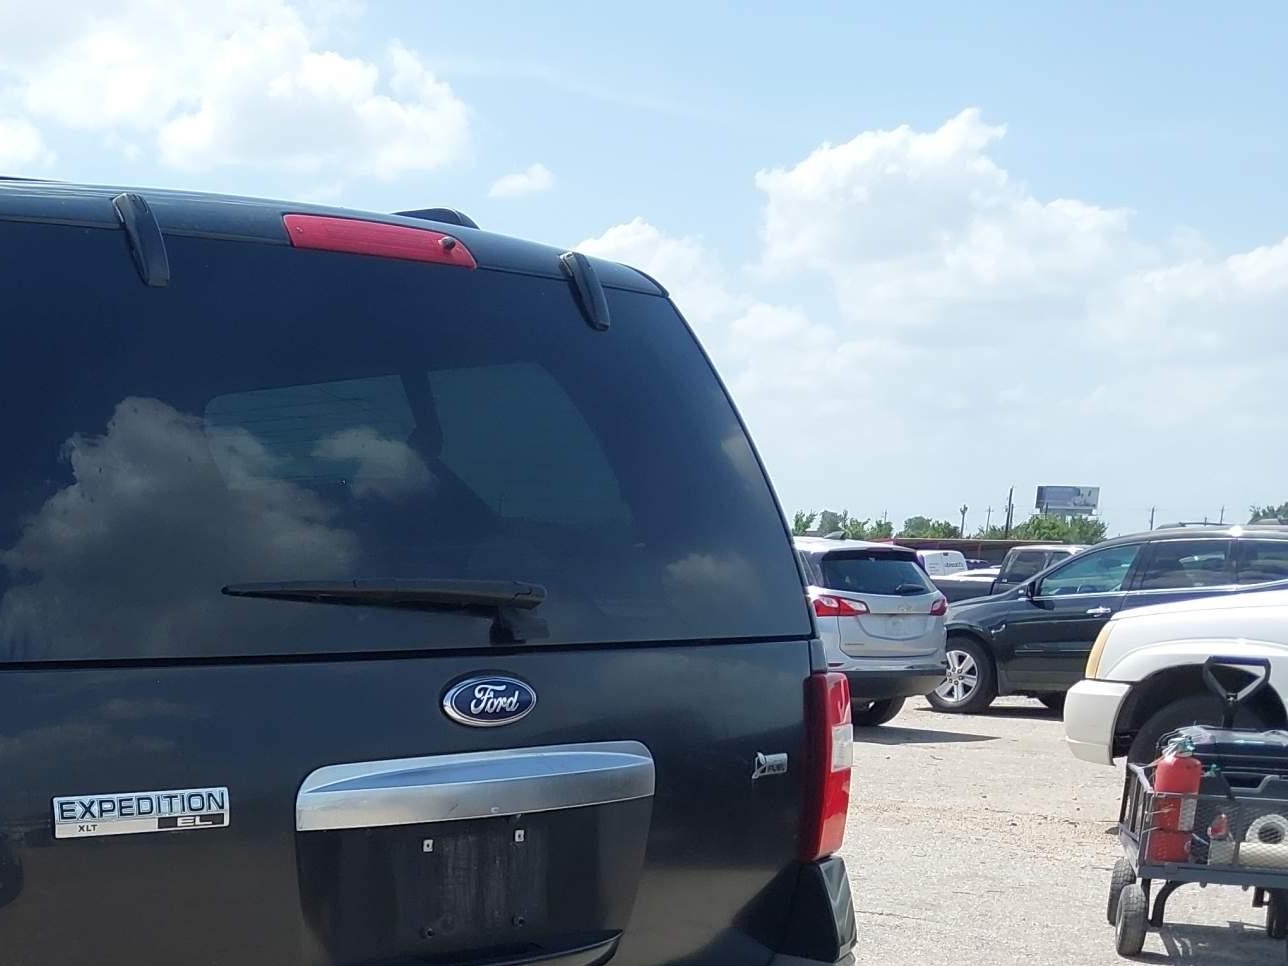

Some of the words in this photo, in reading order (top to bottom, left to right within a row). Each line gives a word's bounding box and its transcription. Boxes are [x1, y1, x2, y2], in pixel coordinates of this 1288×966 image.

[470, 684, 520, 714] Ford
[59, 791, 225, 822] EXPEDITION
[78, 824, 98, 832] XLT
[176, 815, 213, 827] EL
